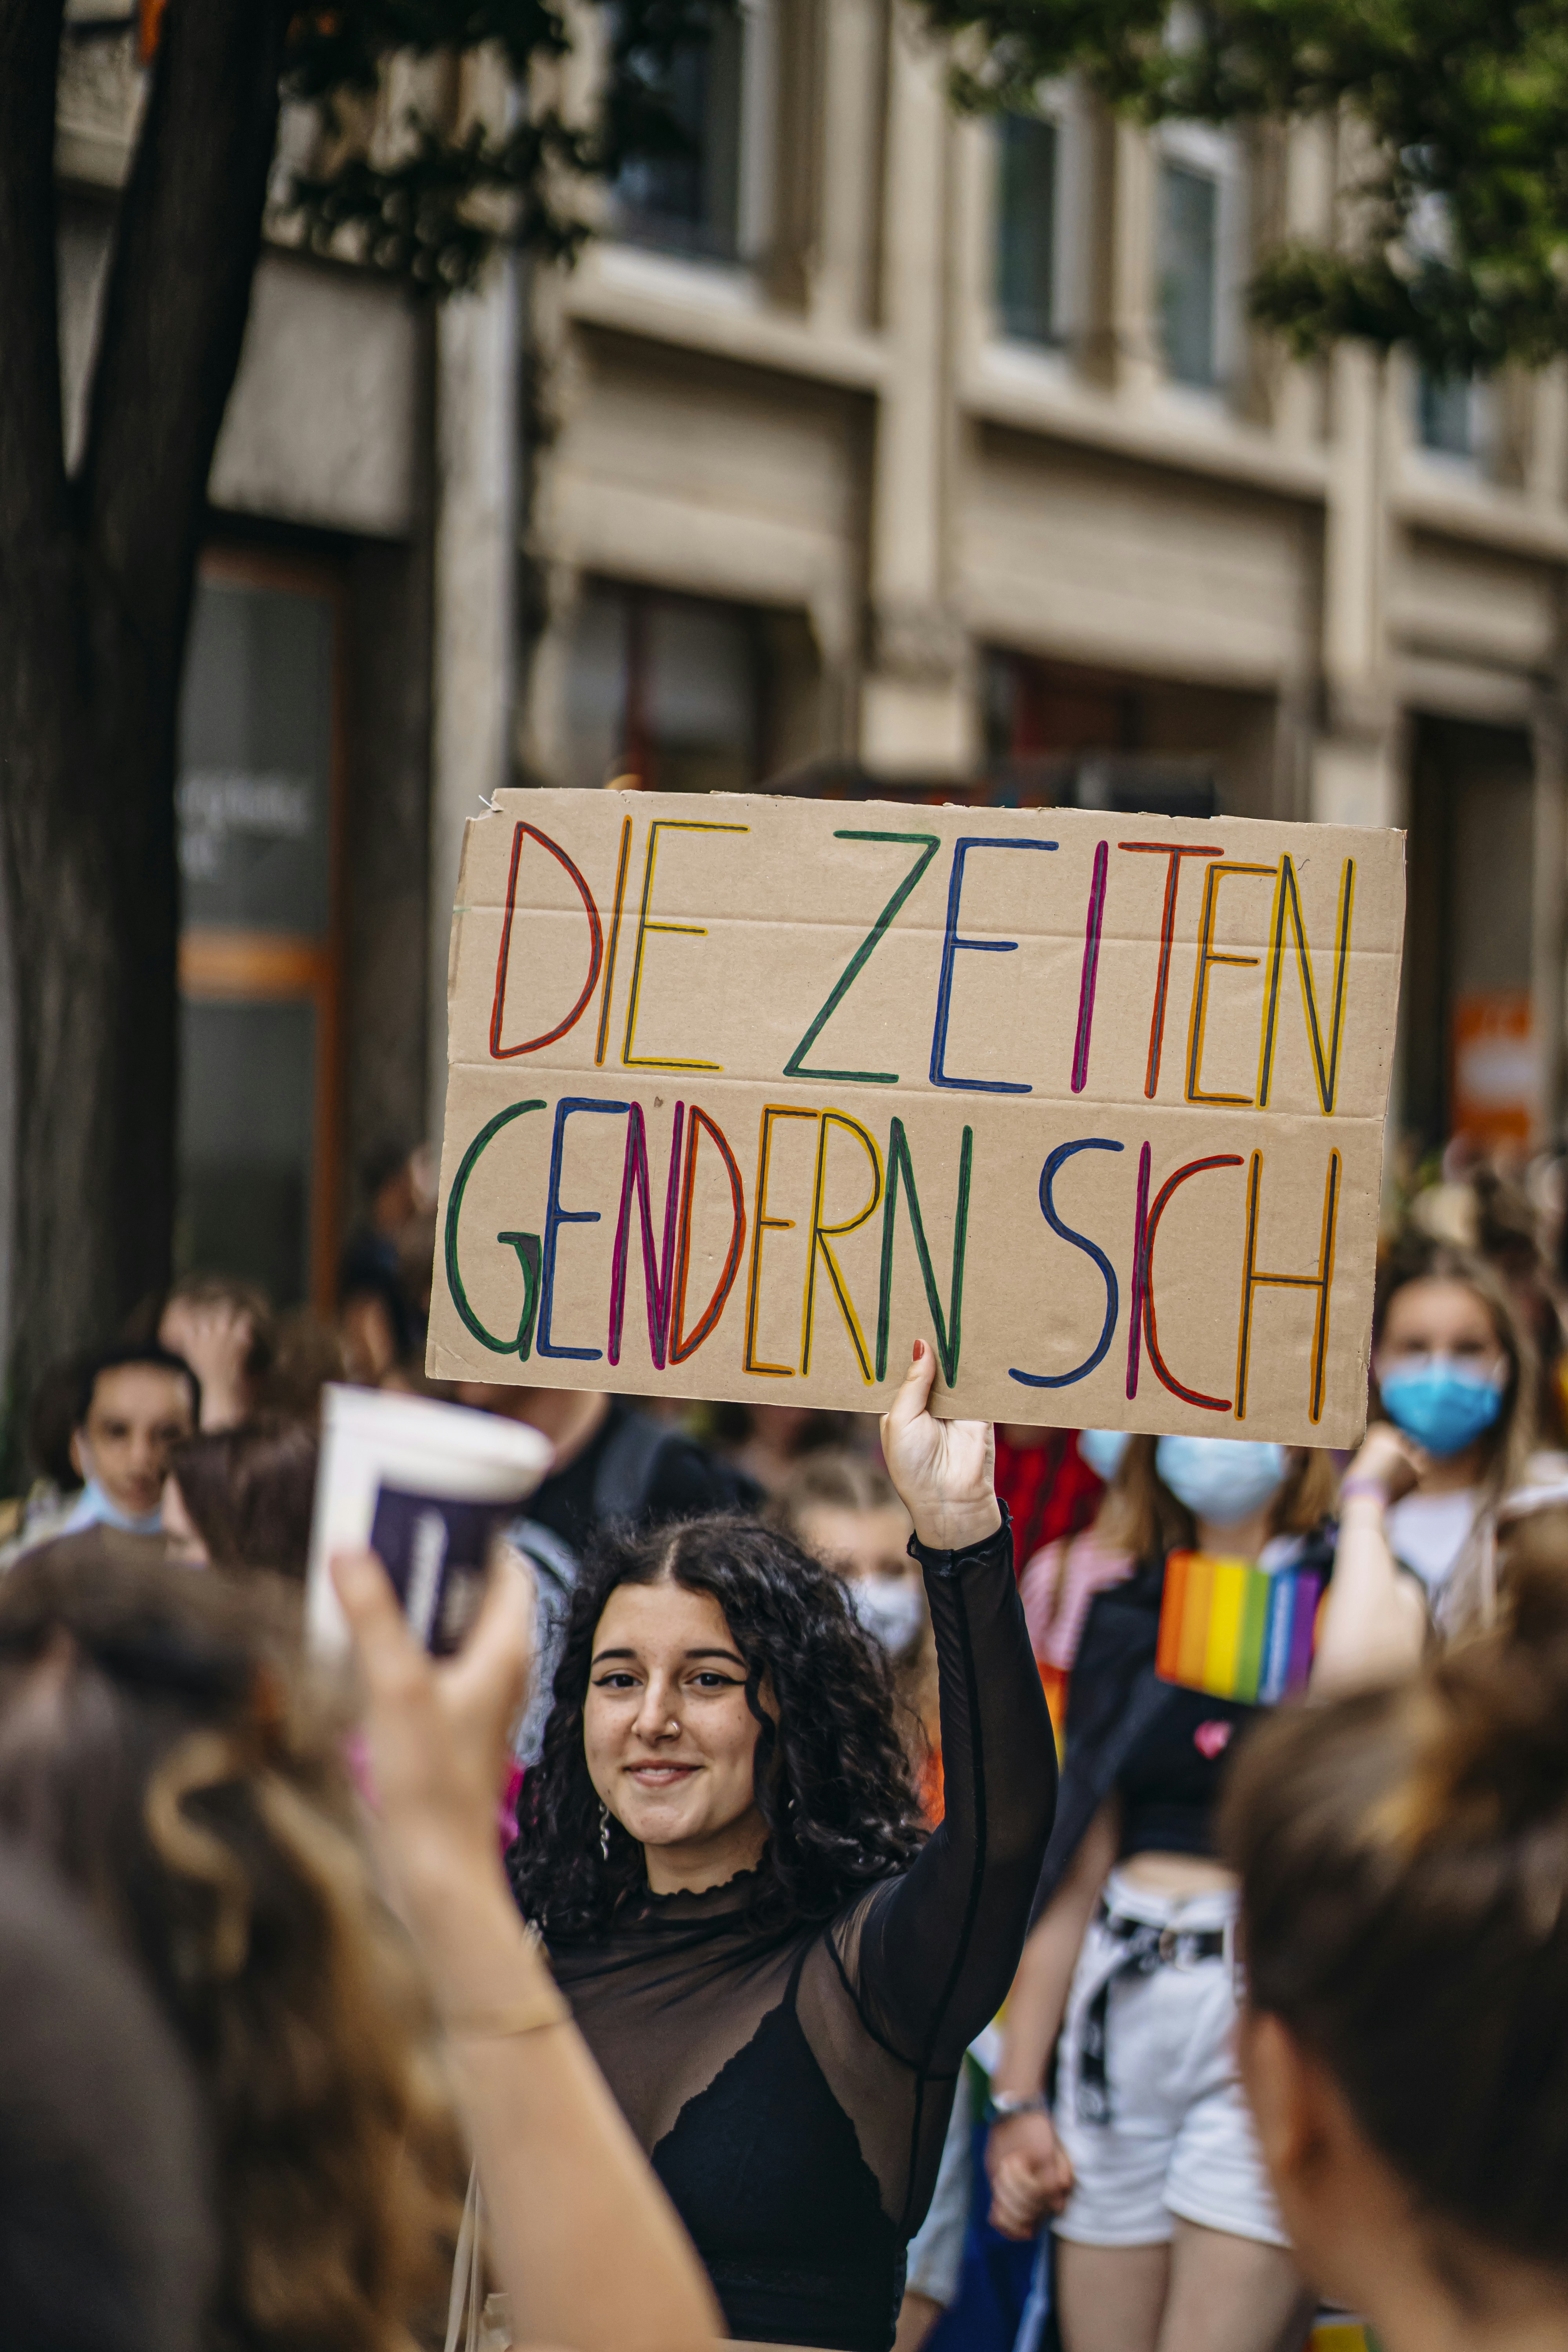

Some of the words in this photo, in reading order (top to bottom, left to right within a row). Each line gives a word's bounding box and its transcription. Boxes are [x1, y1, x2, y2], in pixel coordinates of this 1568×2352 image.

[490, 815, 750, 1072] DIE
[784, 830, 1357, 1113] ZEITEN
[445, 1098, 973, 1388] GENDERN
[1008, 1138, 1341, 1423] SICH
